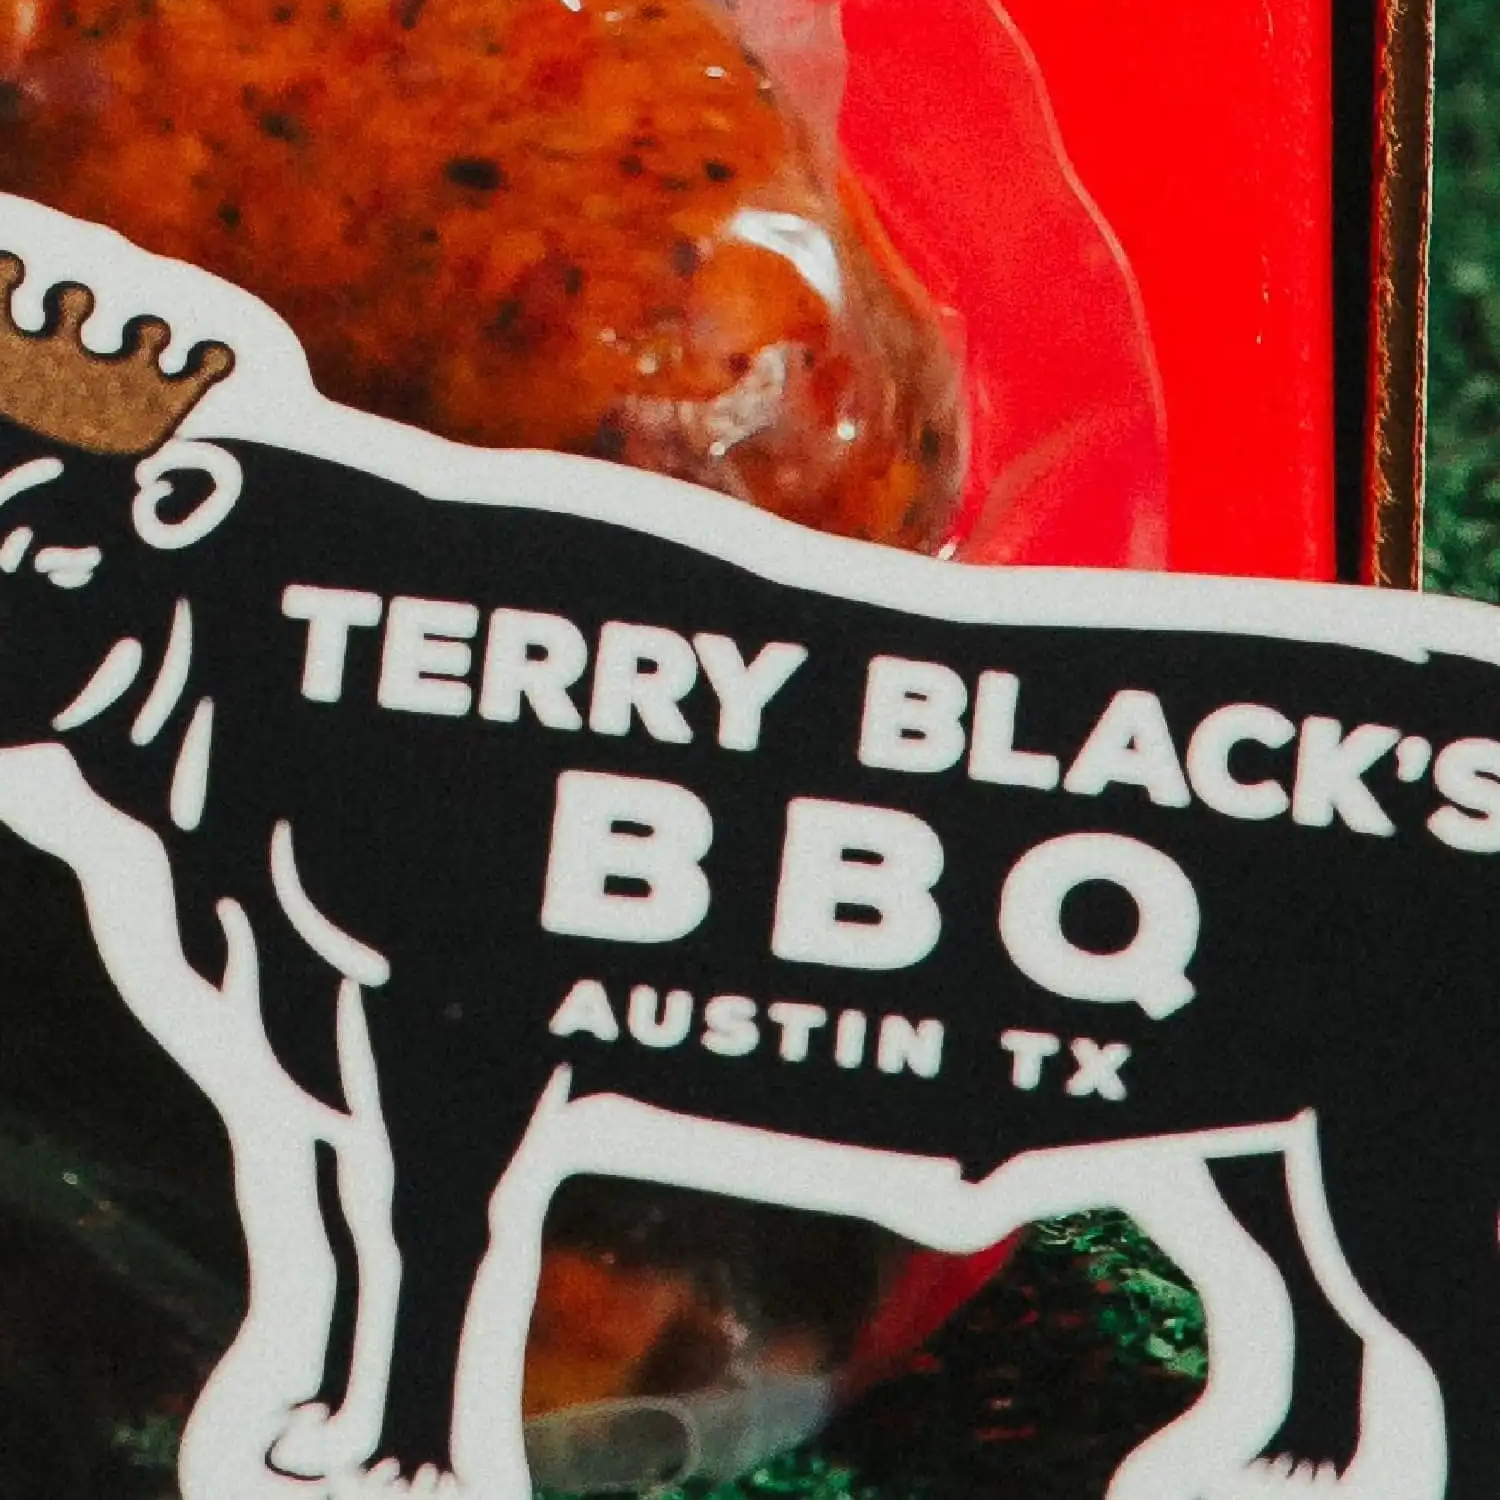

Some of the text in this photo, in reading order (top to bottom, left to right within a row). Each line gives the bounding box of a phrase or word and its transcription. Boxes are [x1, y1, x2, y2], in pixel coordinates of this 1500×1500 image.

[280, 583, 1500, 854] TERRY BLACK'S
[547, 978, 1132, 1102] AUSTIN TX
